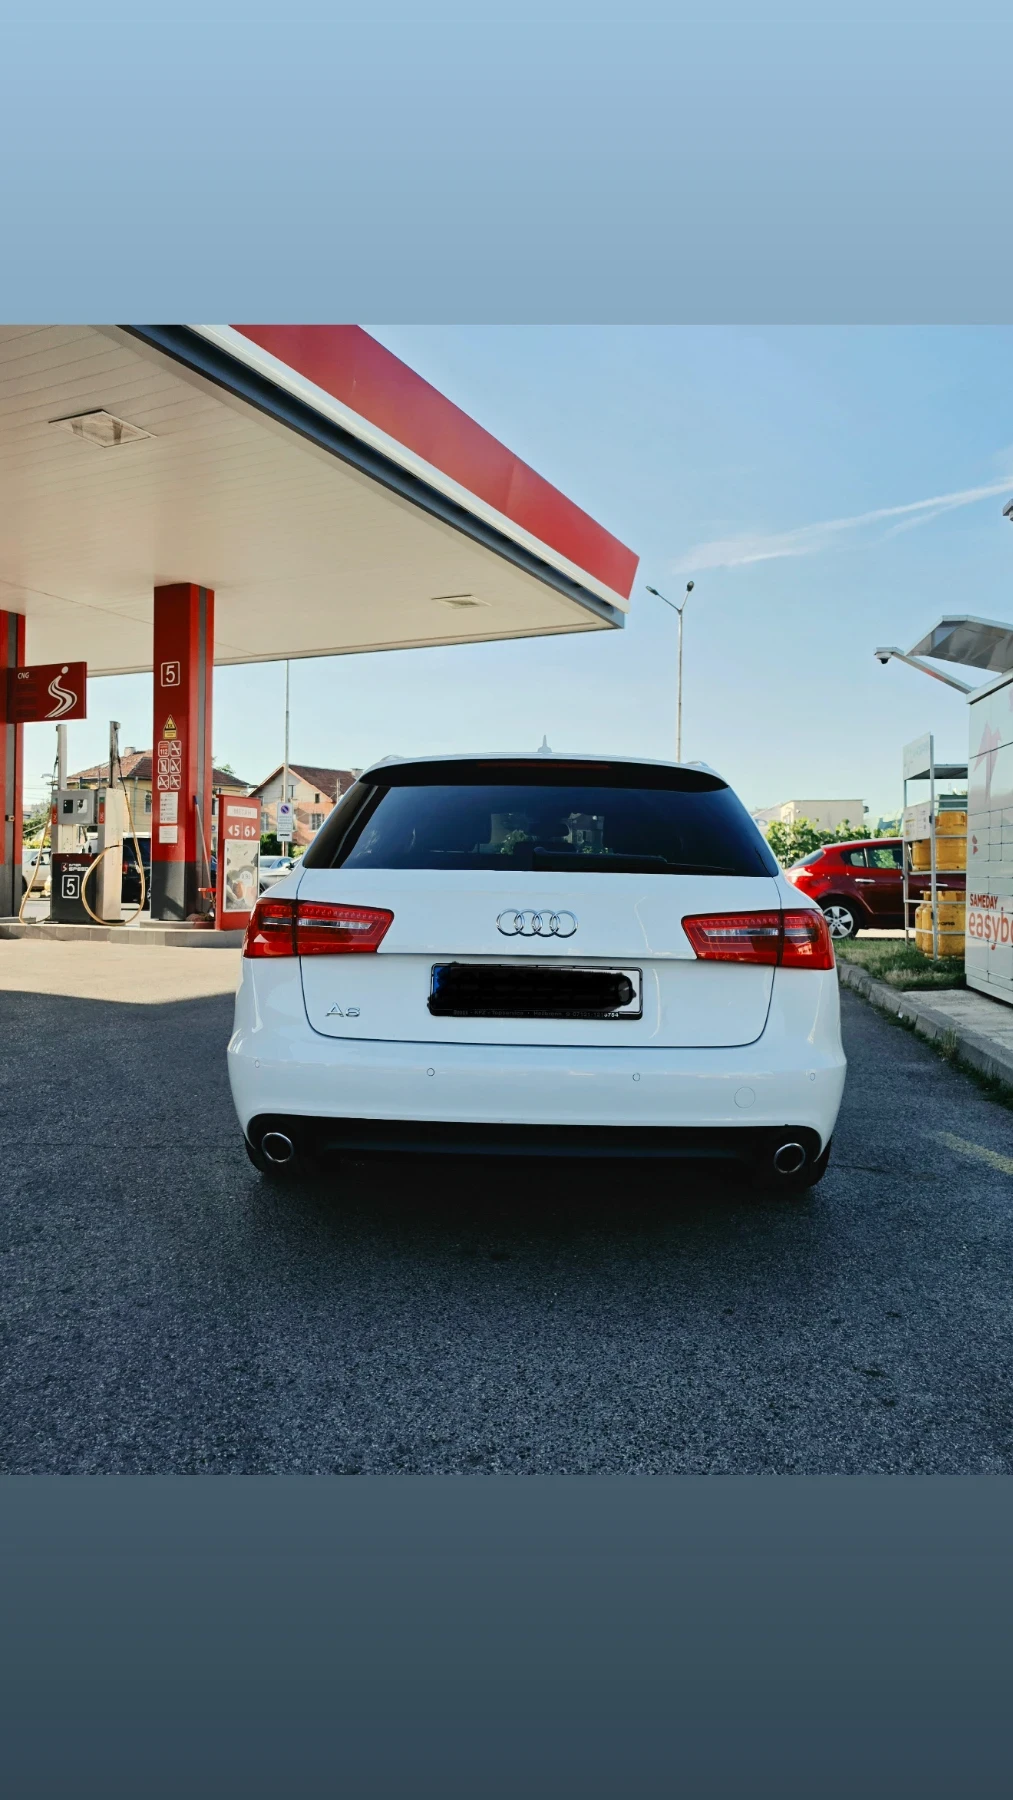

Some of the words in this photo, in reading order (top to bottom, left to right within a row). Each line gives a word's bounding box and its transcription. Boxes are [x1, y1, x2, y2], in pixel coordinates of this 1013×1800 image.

[17, 672, 30, 680] CNG
[165, 664, 176, 683] 5
[233, 824, 240, 837] 5
[244, 825, 251, 838] 6
[66, 878, 76, 896] 5
[969, 893, 998, 910] SAMEDAY
[325, 1001, 361, 1018] A6
